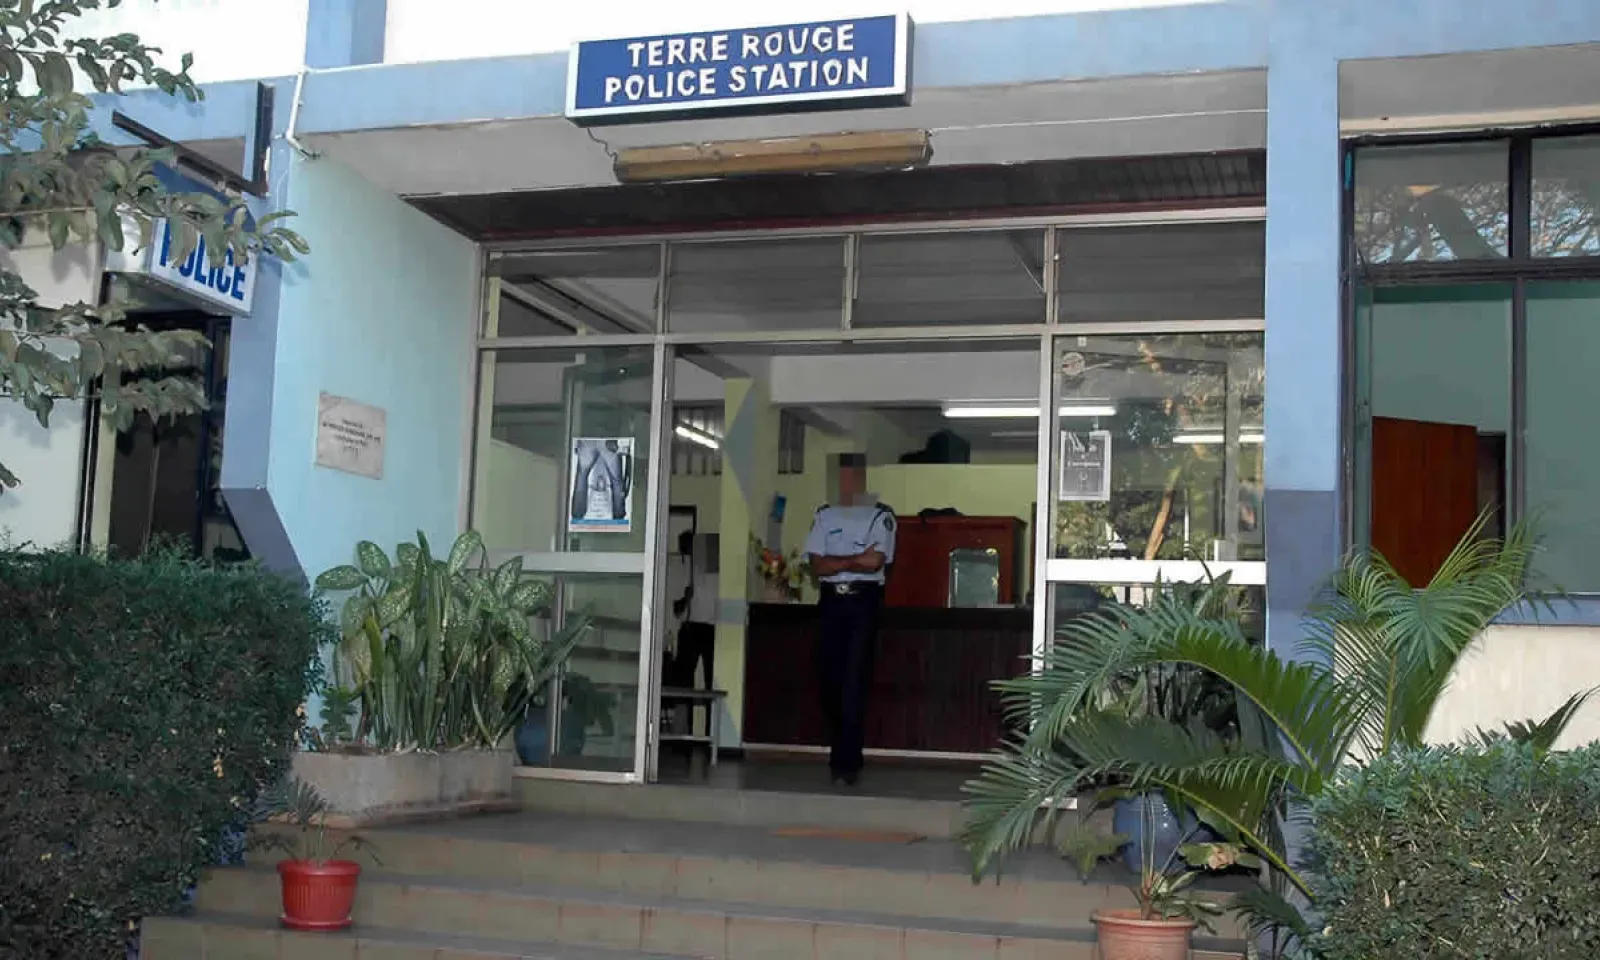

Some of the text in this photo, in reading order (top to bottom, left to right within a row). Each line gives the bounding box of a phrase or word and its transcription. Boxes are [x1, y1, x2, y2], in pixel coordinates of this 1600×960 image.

[628, 24, 854, 67] TERRE ROUGE
[604, 56, 869, 103] POLICE STATION
